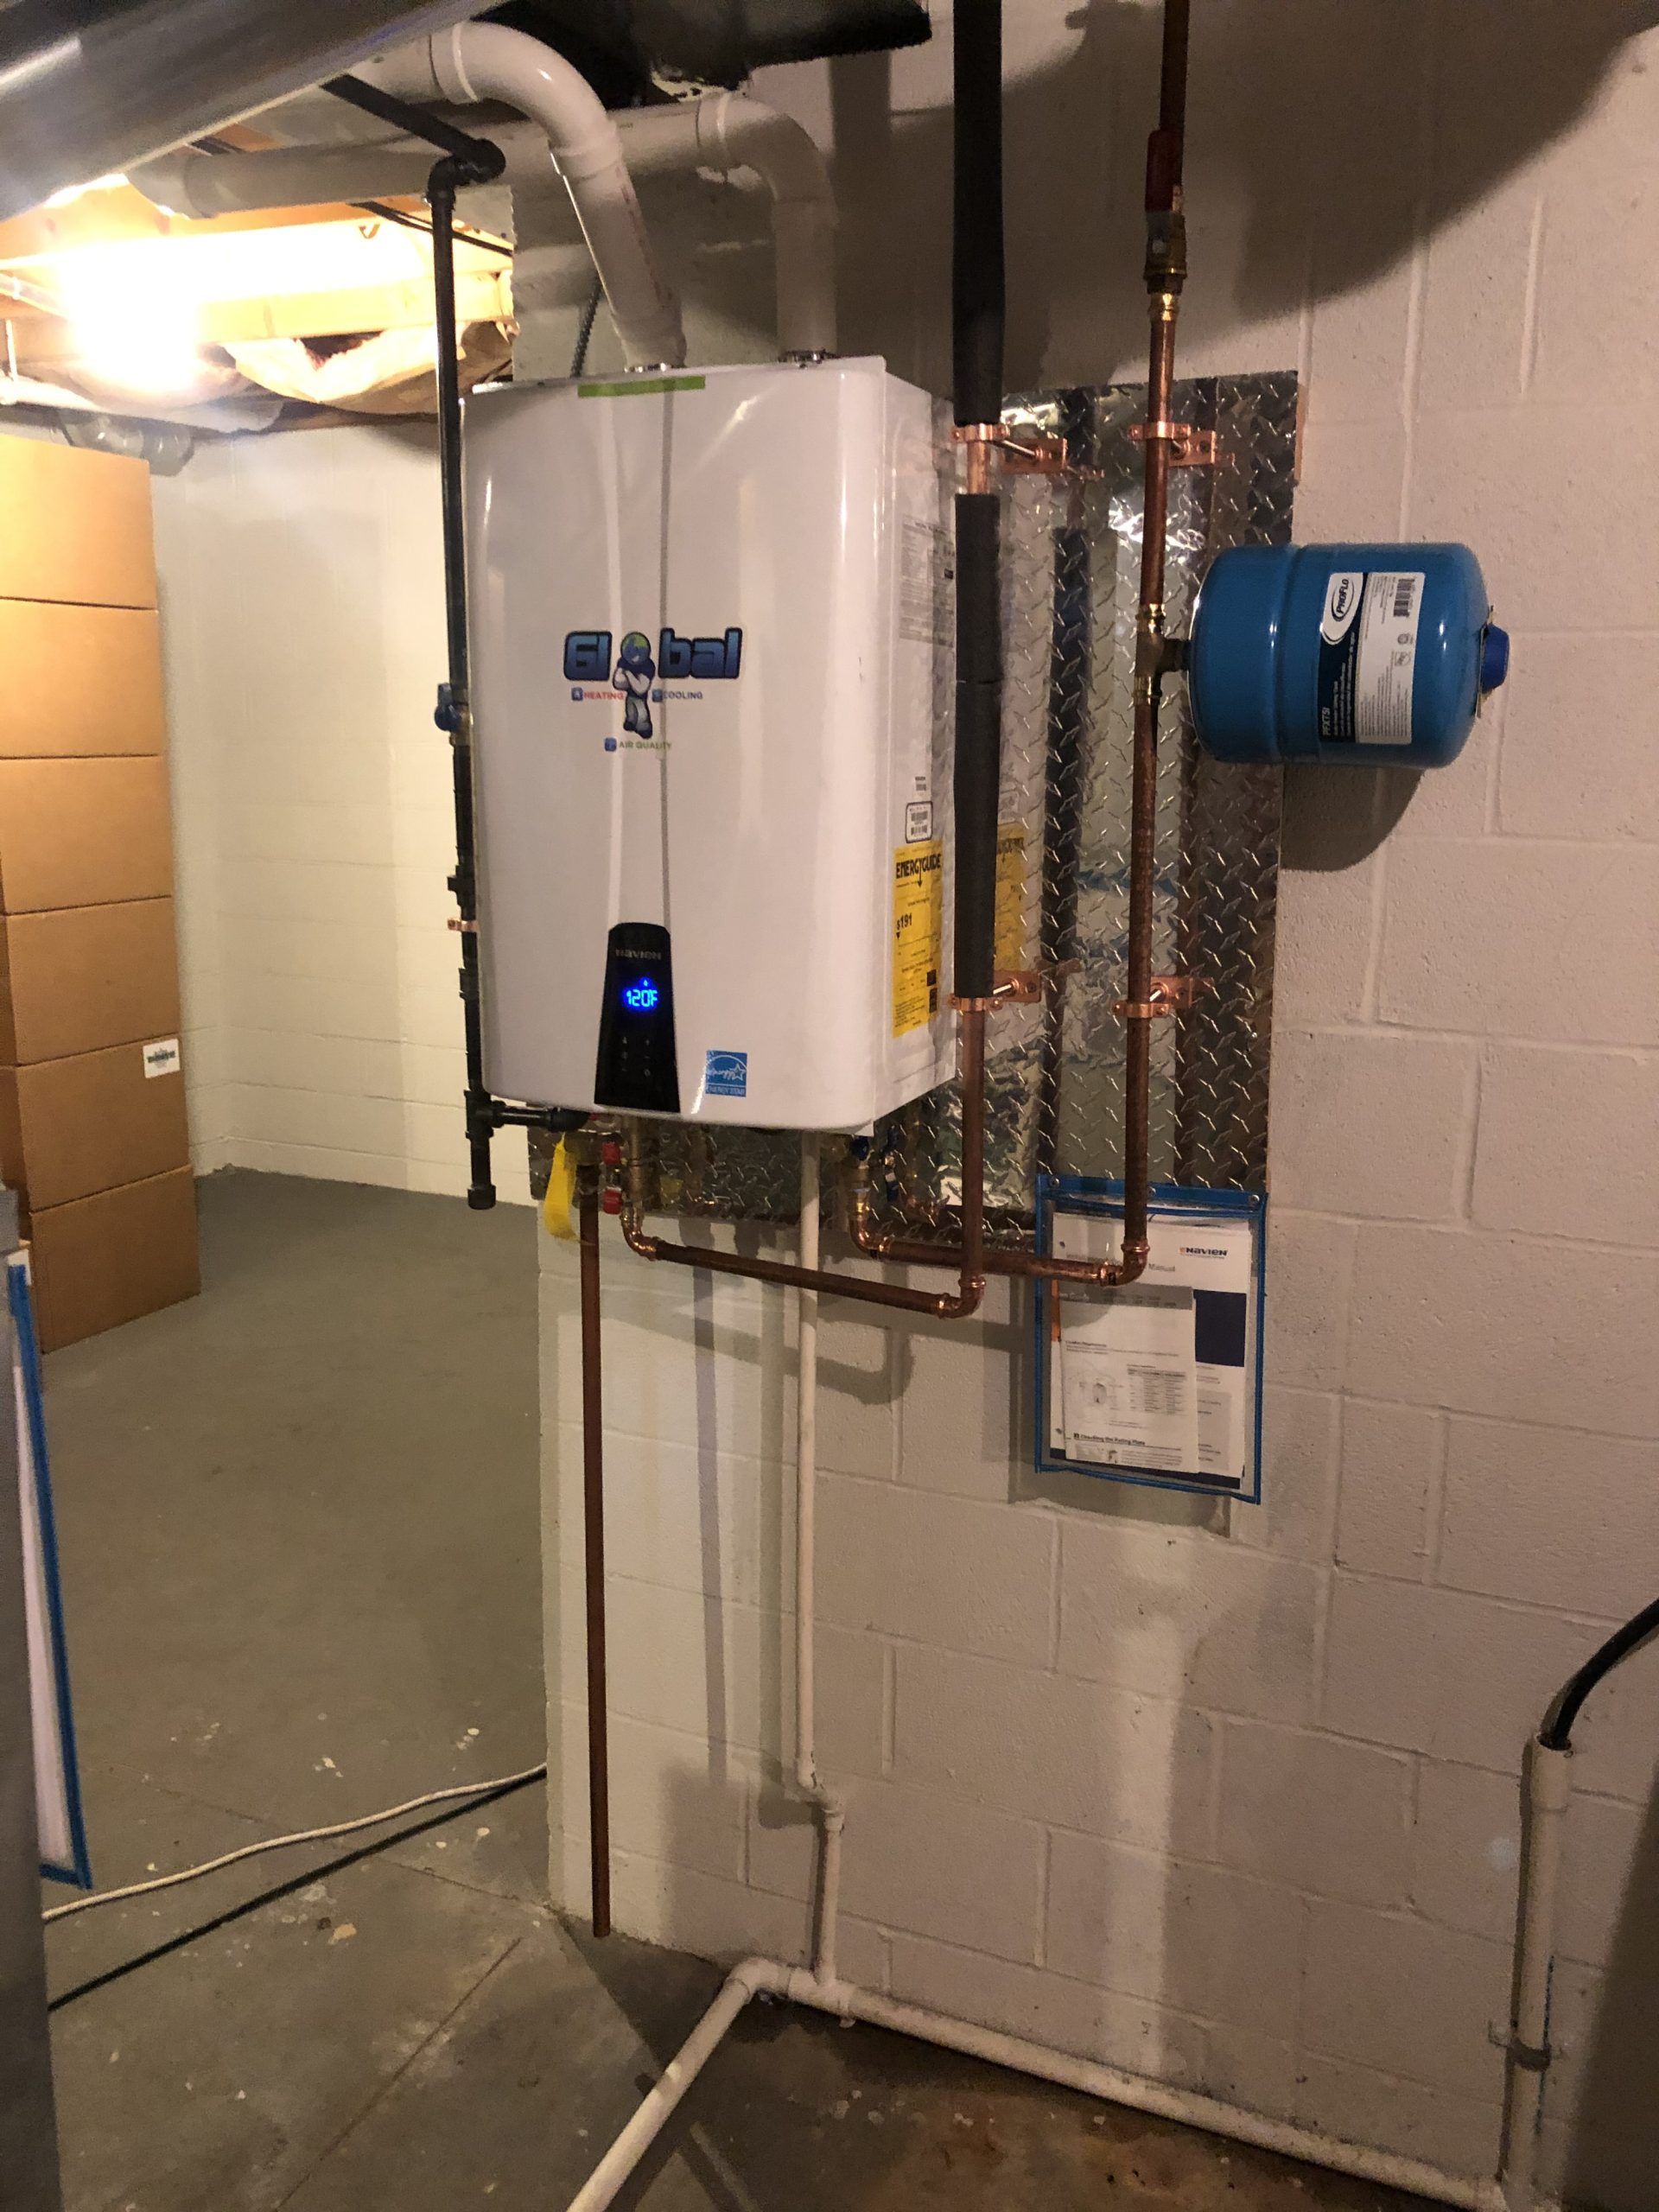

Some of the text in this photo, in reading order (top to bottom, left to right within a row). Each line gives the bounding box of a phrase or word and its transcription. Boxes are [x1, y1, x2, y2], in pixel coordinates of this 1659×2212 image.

[583, 690, 703, 700] HEATING COOLING
[619, 741, 672, 750] AIR QUALITY
[896, 912, 912, 931] $191
